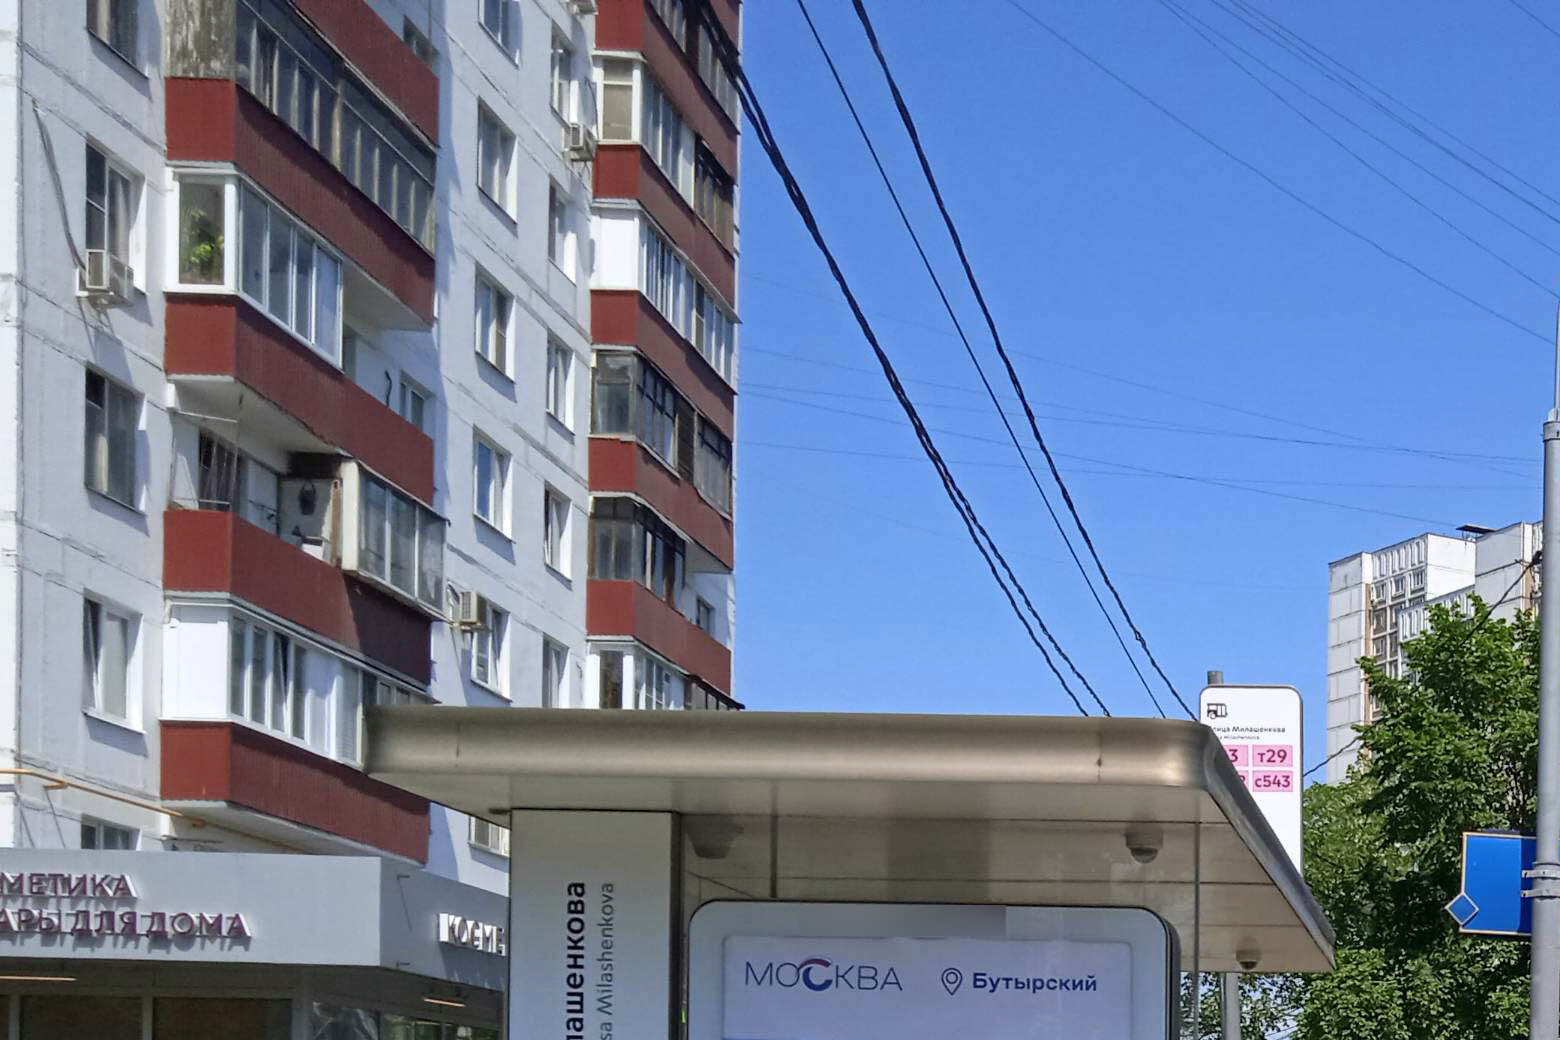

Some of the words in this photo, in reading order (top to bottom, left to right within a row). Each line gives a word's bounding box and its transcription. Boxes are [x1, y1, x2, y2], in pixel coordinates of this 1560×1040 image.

[1228, 748, 1239, 763] 3
[1257, 748, 1288, 764] т29
[1254, 774, 1291, 788] с543
[0, 872, 137, 899] МЕТИКА
[70, 909, 138, 937] ДЛЯ
[147, 910, 251, 938] ДОМА
[595, 882, 615, 1016] Milashenkova
[744, 957, 904, 992] МОСКВА
[972, 972, 1098, 994] Бутырский
